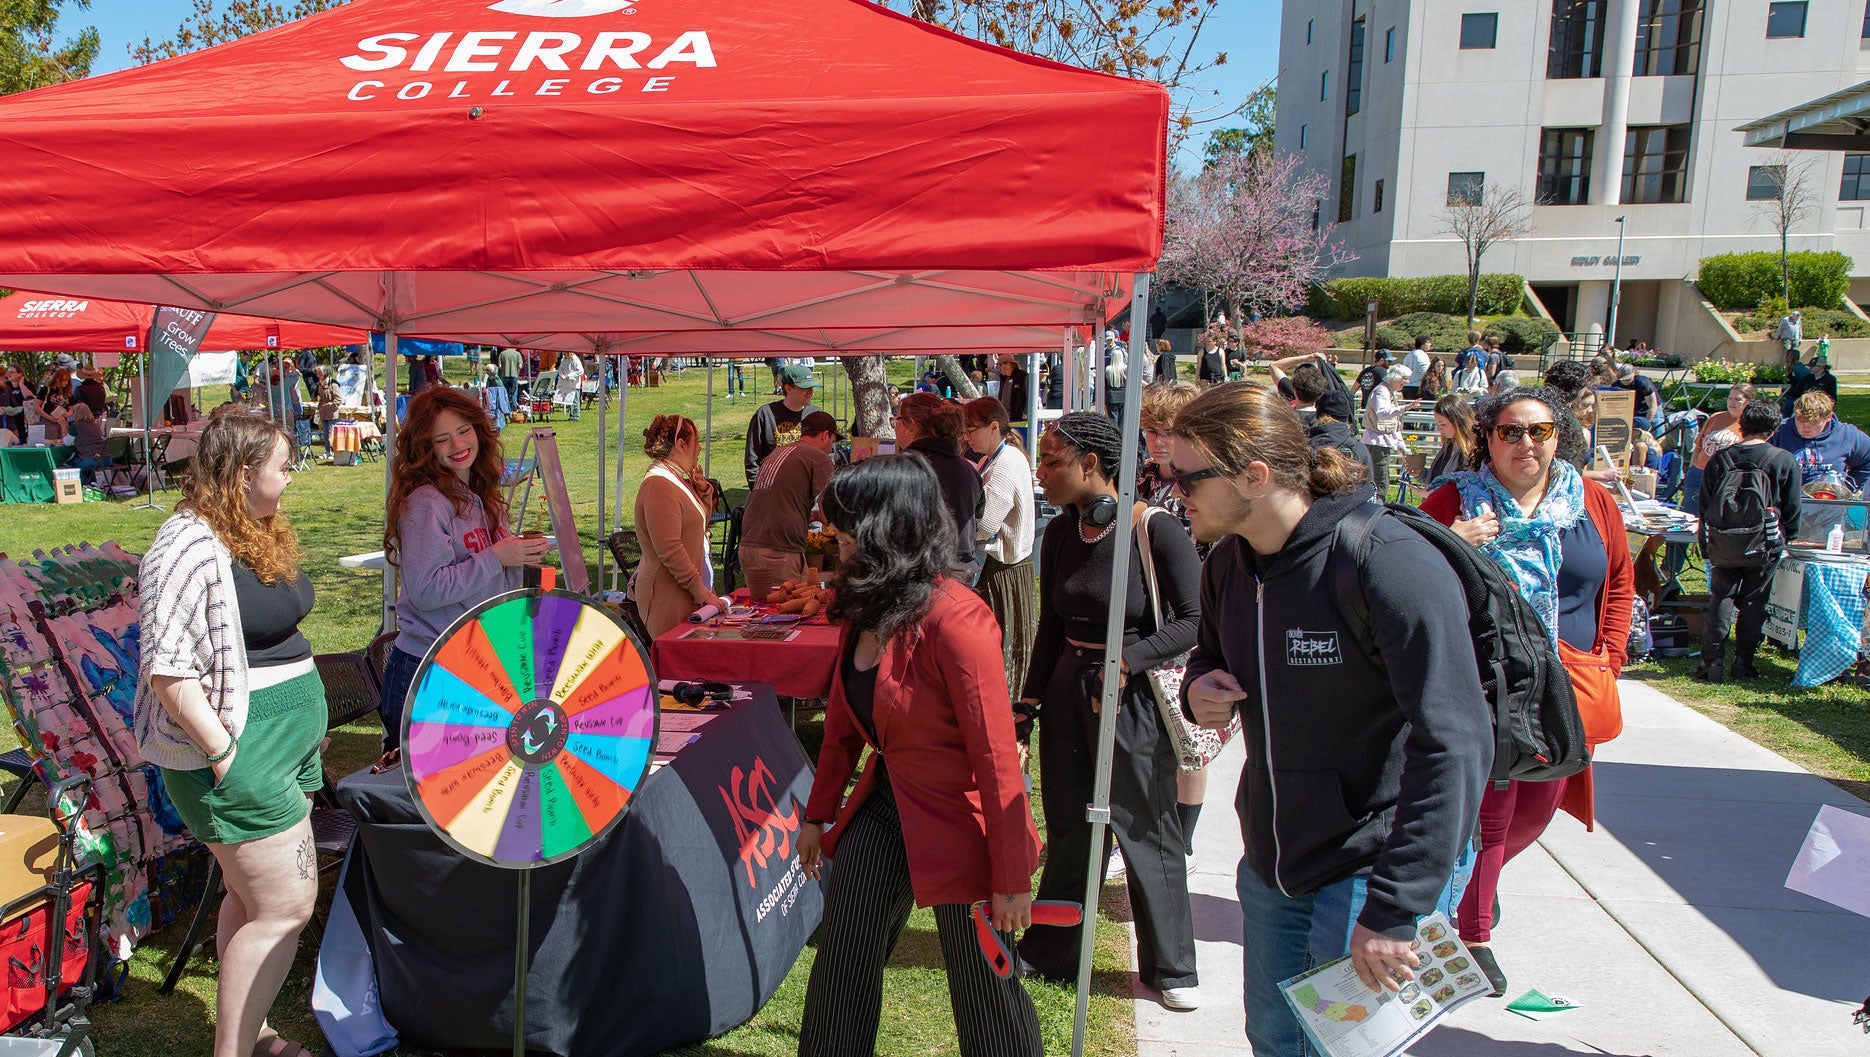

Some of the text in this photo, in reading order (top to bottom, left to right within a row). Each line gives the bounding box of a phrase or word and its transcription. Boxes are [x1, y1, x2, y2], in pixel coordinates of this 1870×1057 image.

[339, 31, 718, 72] SIERRA
[347, 76, 676, 100] COLLEGE
[19, 300, 89, 313] SIERRA
[159, 331, 188, 357] Trees
[167, 321, 196, 345] Grow
[543, 628, 562, 686] Seed Bomb
[1289, 638, 1337, 658] REBEL
[1290, 656, 1339, 664] RESTAURANT
[578, 690, 598, 706] Seed
[511, 701, 538, 747] SPIN TO WIN
[443, 731, 498, 747] Seed Bomb
[541, 715, 567, 760] SPIN TO WIN
[573, 741, 619, 765] Seed Bomb
[482, 766, 516, 813] Seed Bomb
[542, 769, 558, 827] Seed Bomb
[756, 853, 801, 923] ASSOCIATED STU
